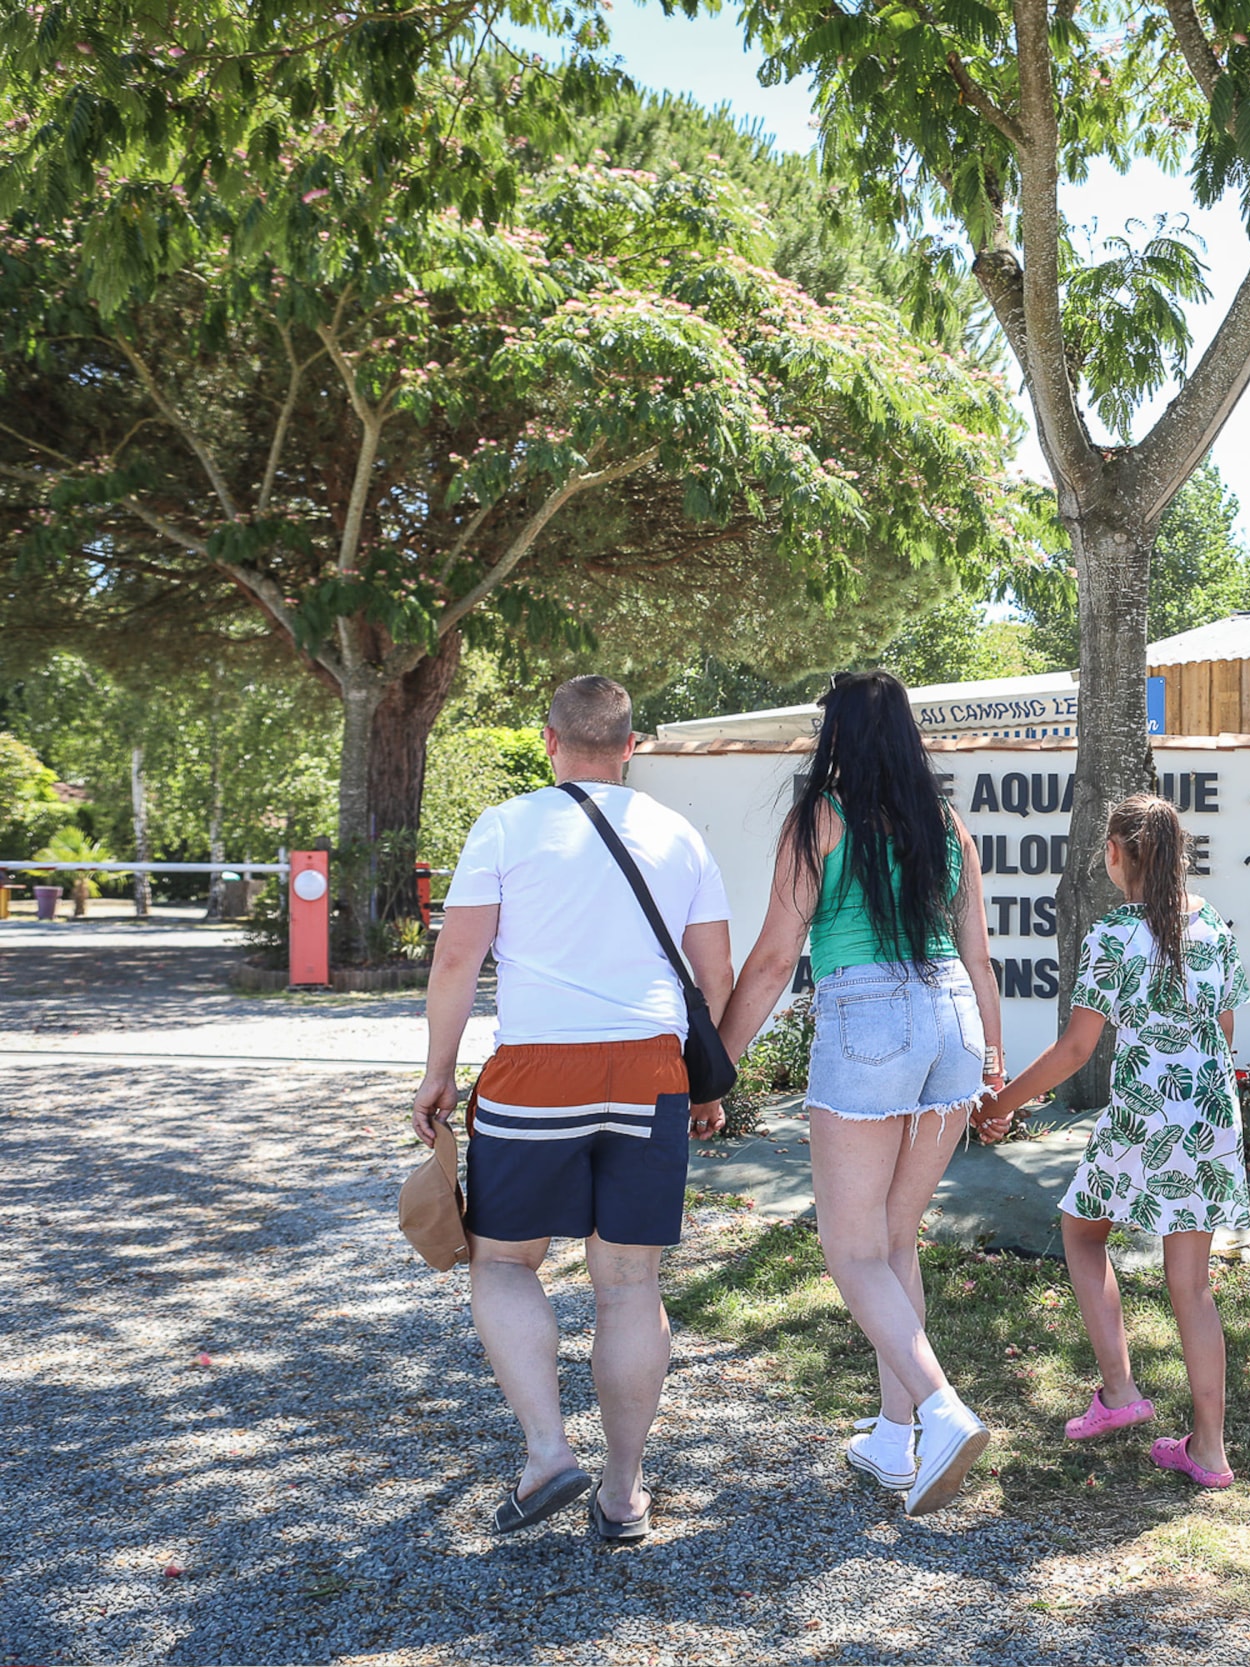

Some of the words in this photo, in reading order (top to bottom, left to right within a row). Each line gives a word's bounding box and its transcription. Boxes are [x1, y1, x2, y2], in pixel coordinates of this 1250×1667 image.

[920, 707, 945, 725] AU
[949, 699, 1046, 722] CAMPING
[1052, 697, 1078, 715] LE
